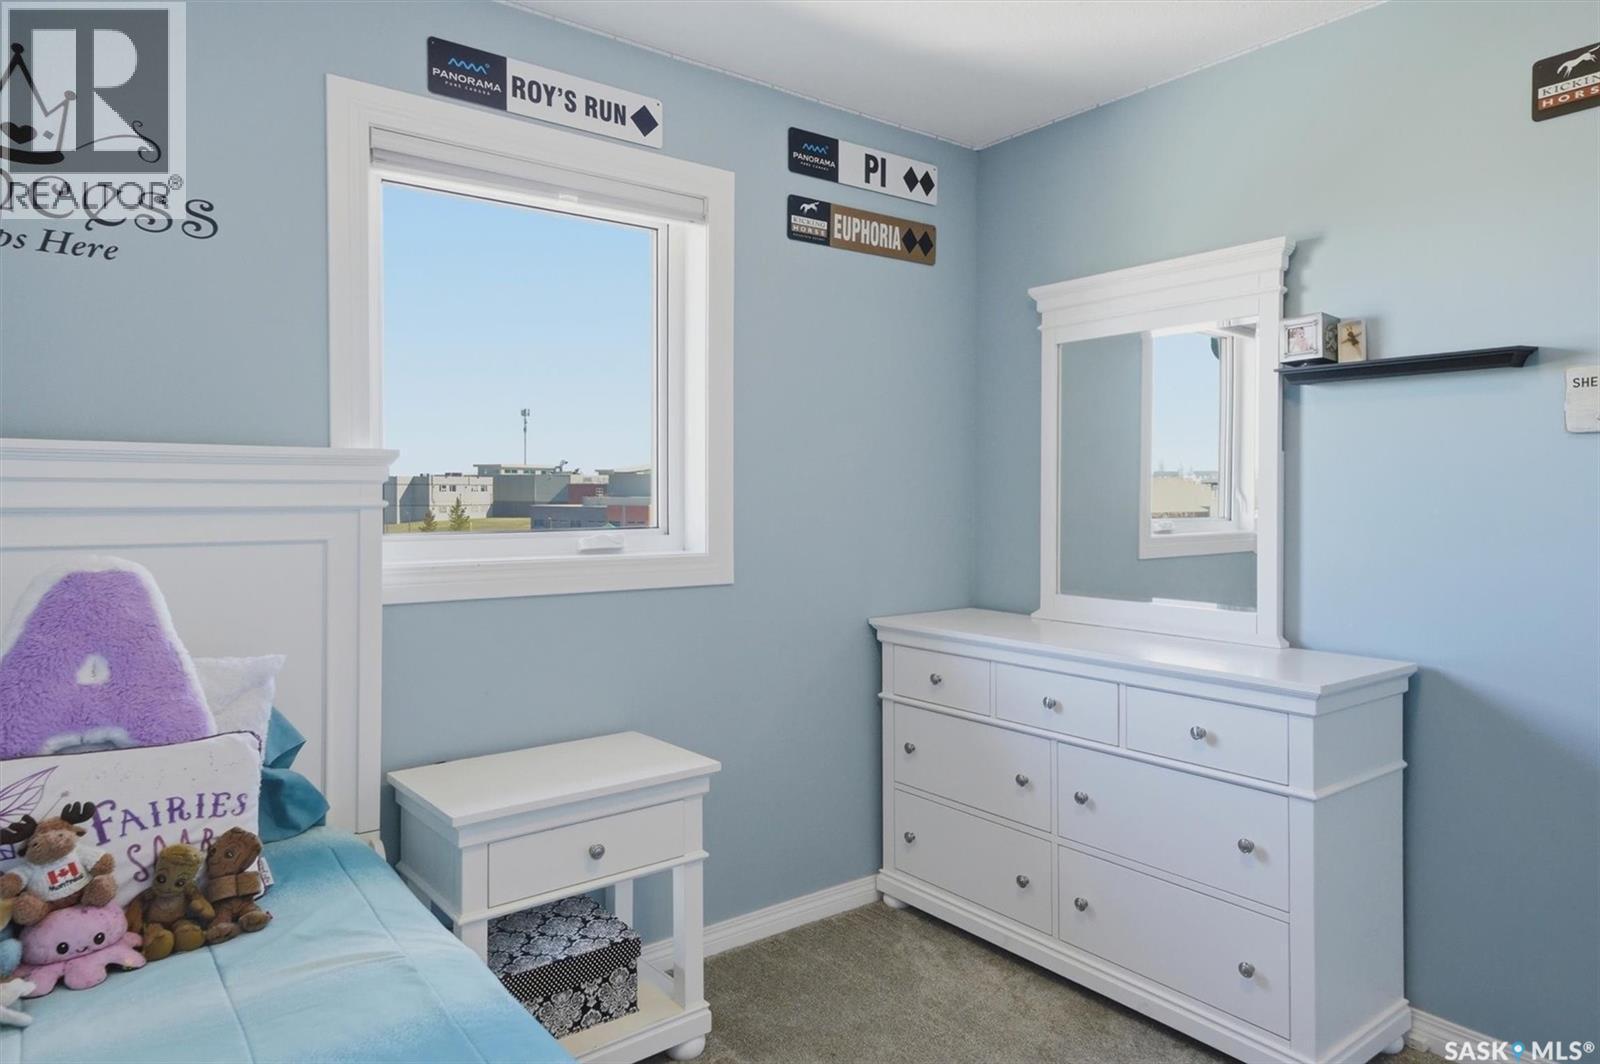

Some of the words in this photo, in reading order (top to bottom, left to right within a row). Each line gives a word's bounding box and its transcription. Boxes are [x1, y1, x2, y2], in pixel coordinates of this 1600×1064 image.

[432, 67, 502, 93] PANORAMA
[511, 75, 577, 114] ROY'S
[584, 95, 627, 127] RUN
[793, 151, 836, 169] PANORAMA
[864, 153, 887, 188] PI
[35, 228, 119, 260] Here
[833, 213, 901, 251] EUPHORIA
[1572, 376, 1599, 388] SHE
[91, 792, 249, 847] FAIRIES
